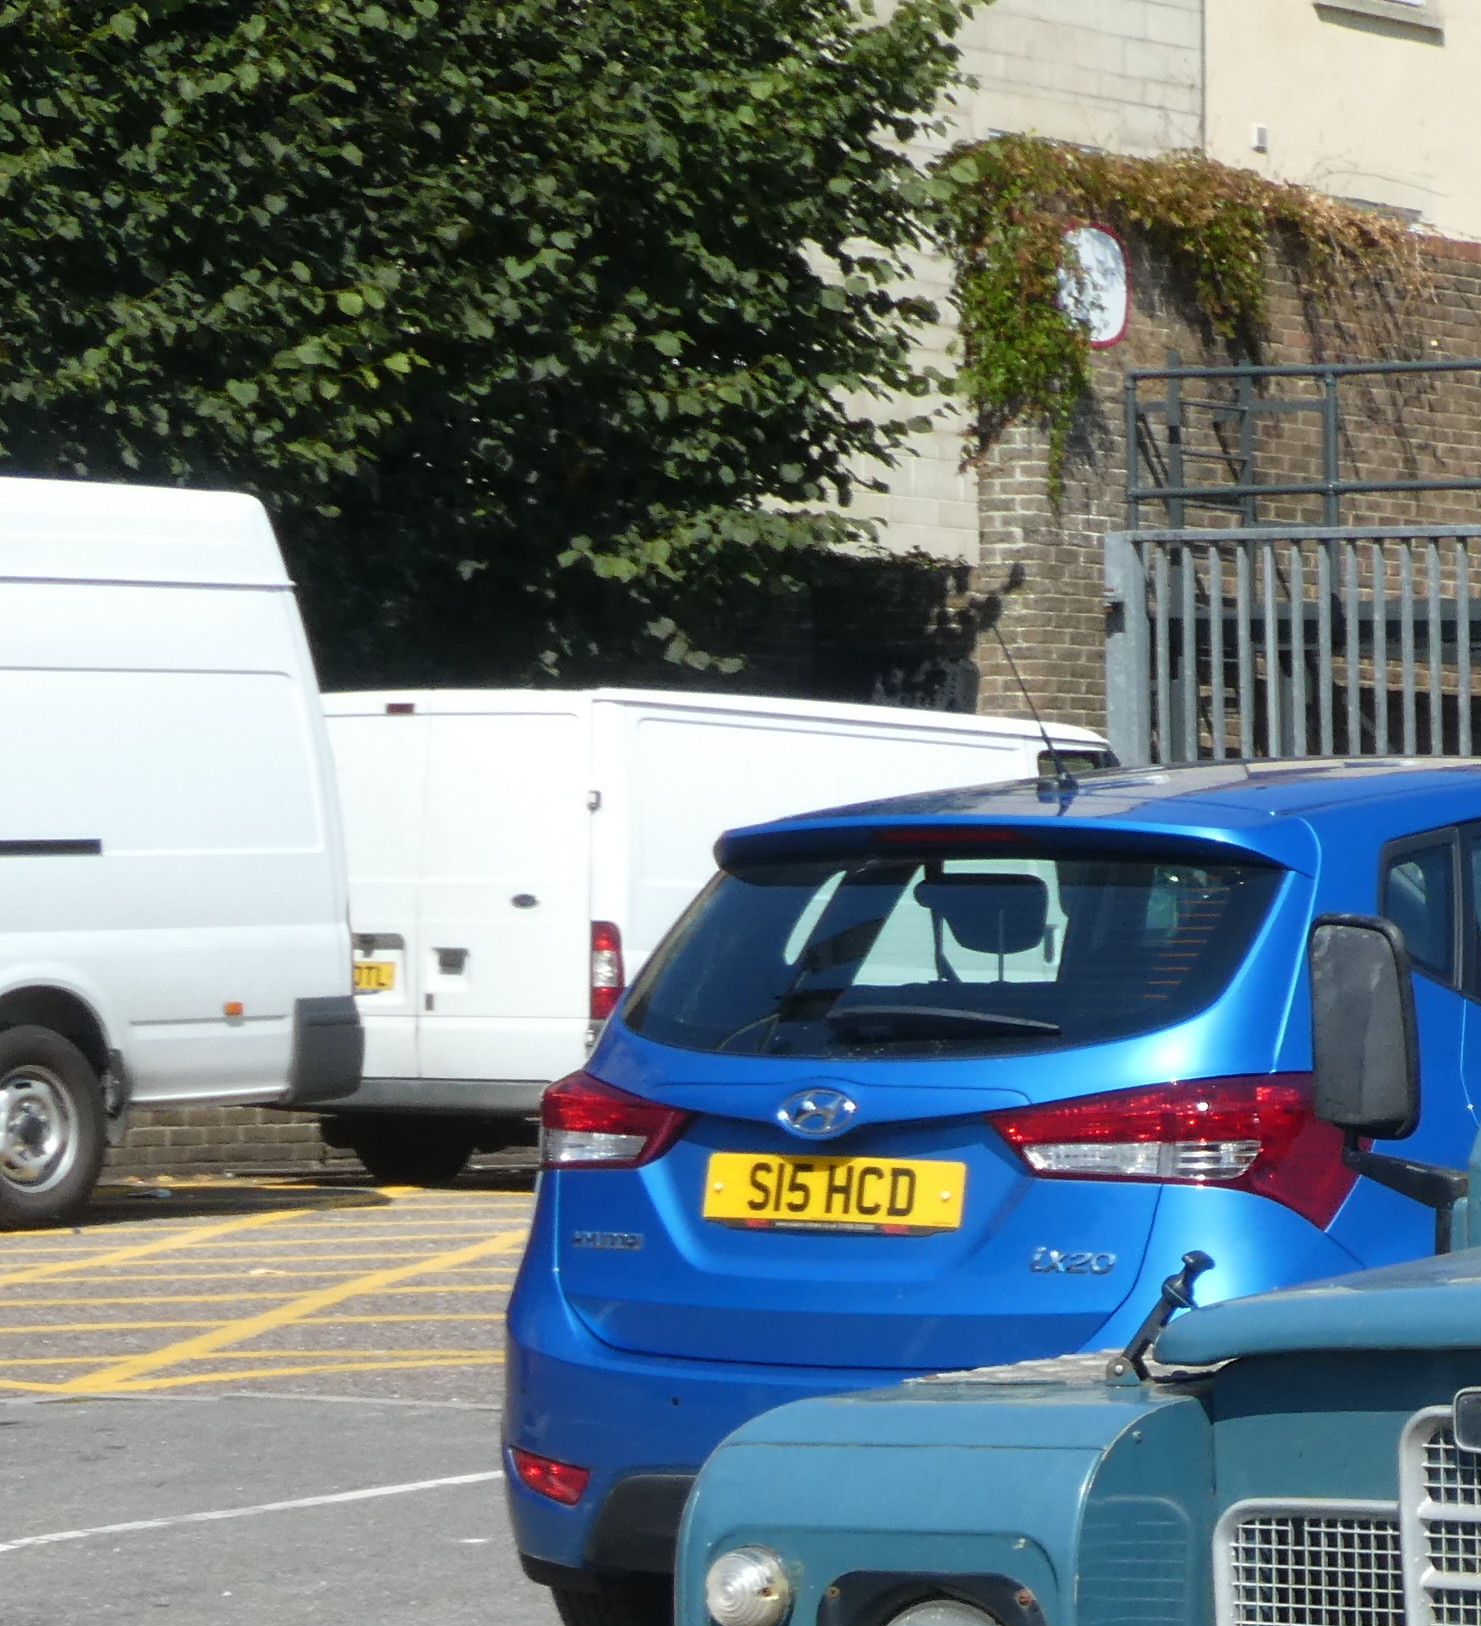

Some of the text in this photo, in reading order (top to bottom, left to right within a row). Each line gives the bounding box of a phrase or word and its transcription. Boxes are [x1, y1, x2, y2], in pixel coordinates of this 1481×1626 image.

[747, 1161, 916, 1218] S15 HCD
[1030, 1246, 1116, 1275] ix20
